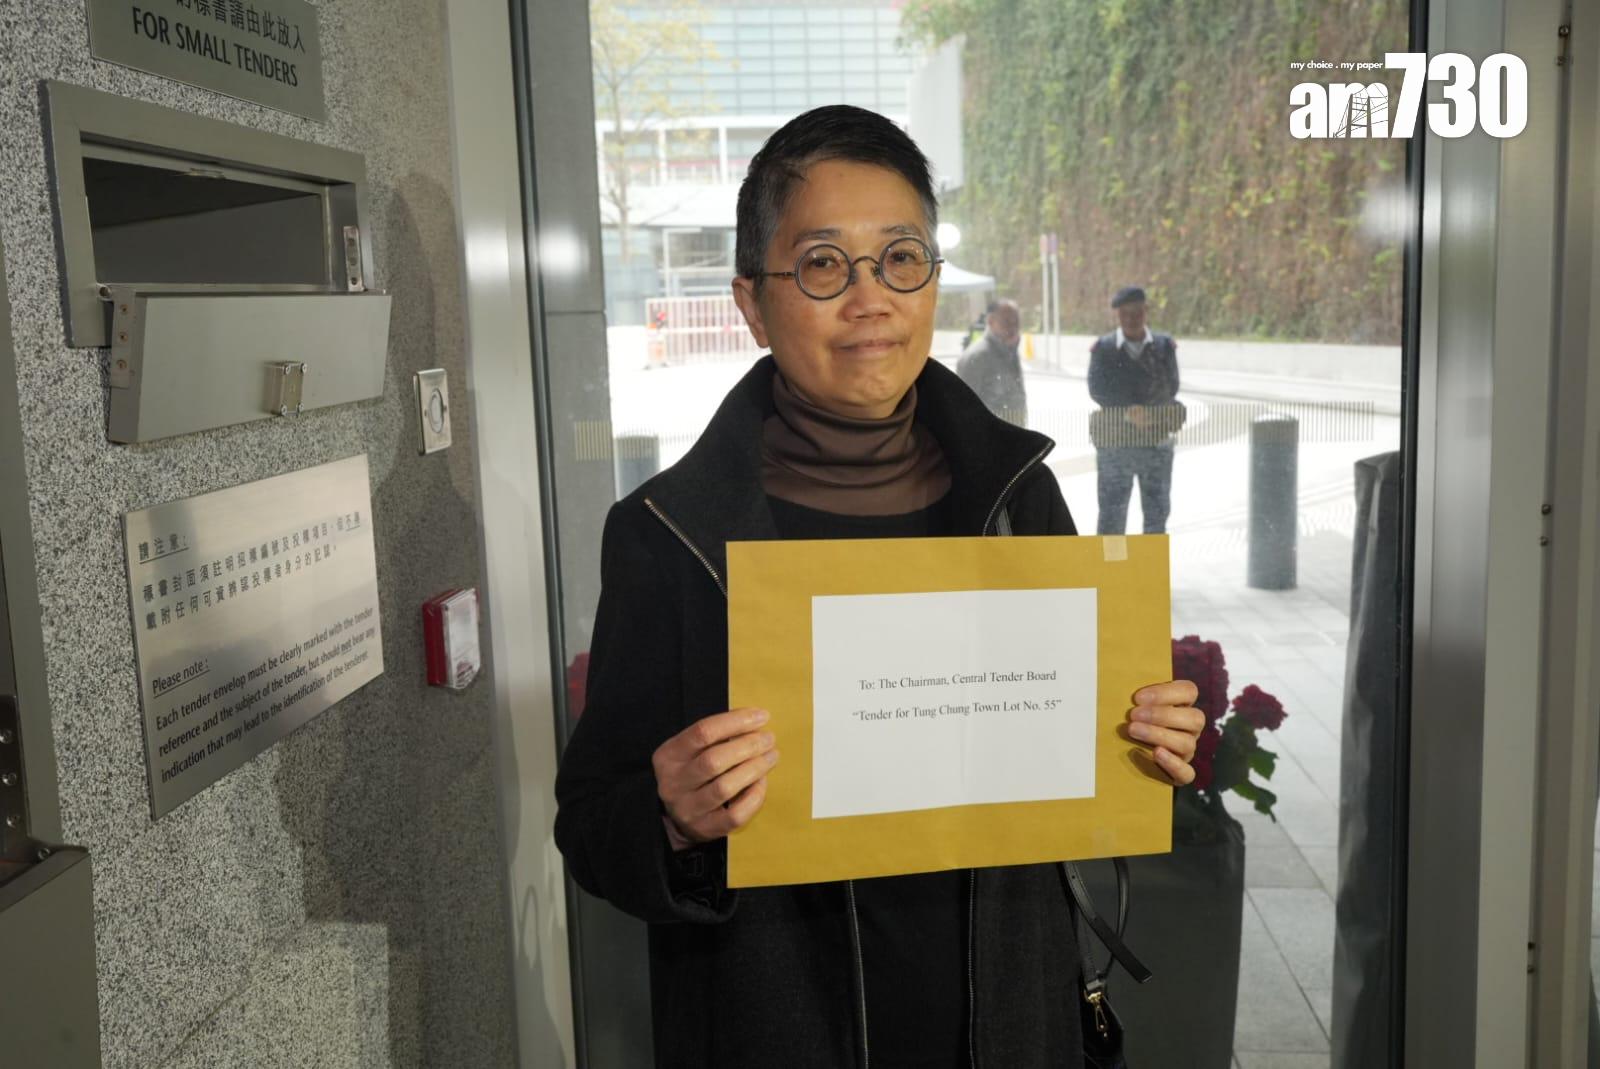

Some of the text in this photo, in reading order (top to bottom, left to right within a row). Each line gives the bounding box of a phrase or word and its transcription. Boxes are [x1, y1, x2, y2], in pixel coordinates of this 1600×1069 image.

[132, 6, 298, 87] FOR SMALL TENDERS
[177, 0, 305, 54] 書請由此放入
[152, 671, 181, 694] Please
[183, 660, 204, 678] note
[156, 607, 373, 731] Each tender envelop must be clearly marked with the tender
[159, 627, 375, 757] reference and the subject of the tender, but should not bear any
[859, 670, 1057, 690] To: The Chairman, Central Tender Board
[161, 747, 206, 784] indication
[207, 735, 224, 755] that
[226, 726, 243, 746] may
[244, 712, 260, 733] lead
[261, 709, 269, 722] to
[270, 702, 282, 717] the
[283, 676, 325, 709] identification
[326, 668, 333, 682] of
[333, 666, 343, 678] the
[852, 710, 892, 721] “Tender
[895, 707, 909, 718] for
[912, 706, 937, 719] Tung
[939, 704, 970, 717] Chung
[972, 702, 1000, 712] Town
[1003, 701, 1020, 711] Lot
[1023, 700, 1041, 711] No.
